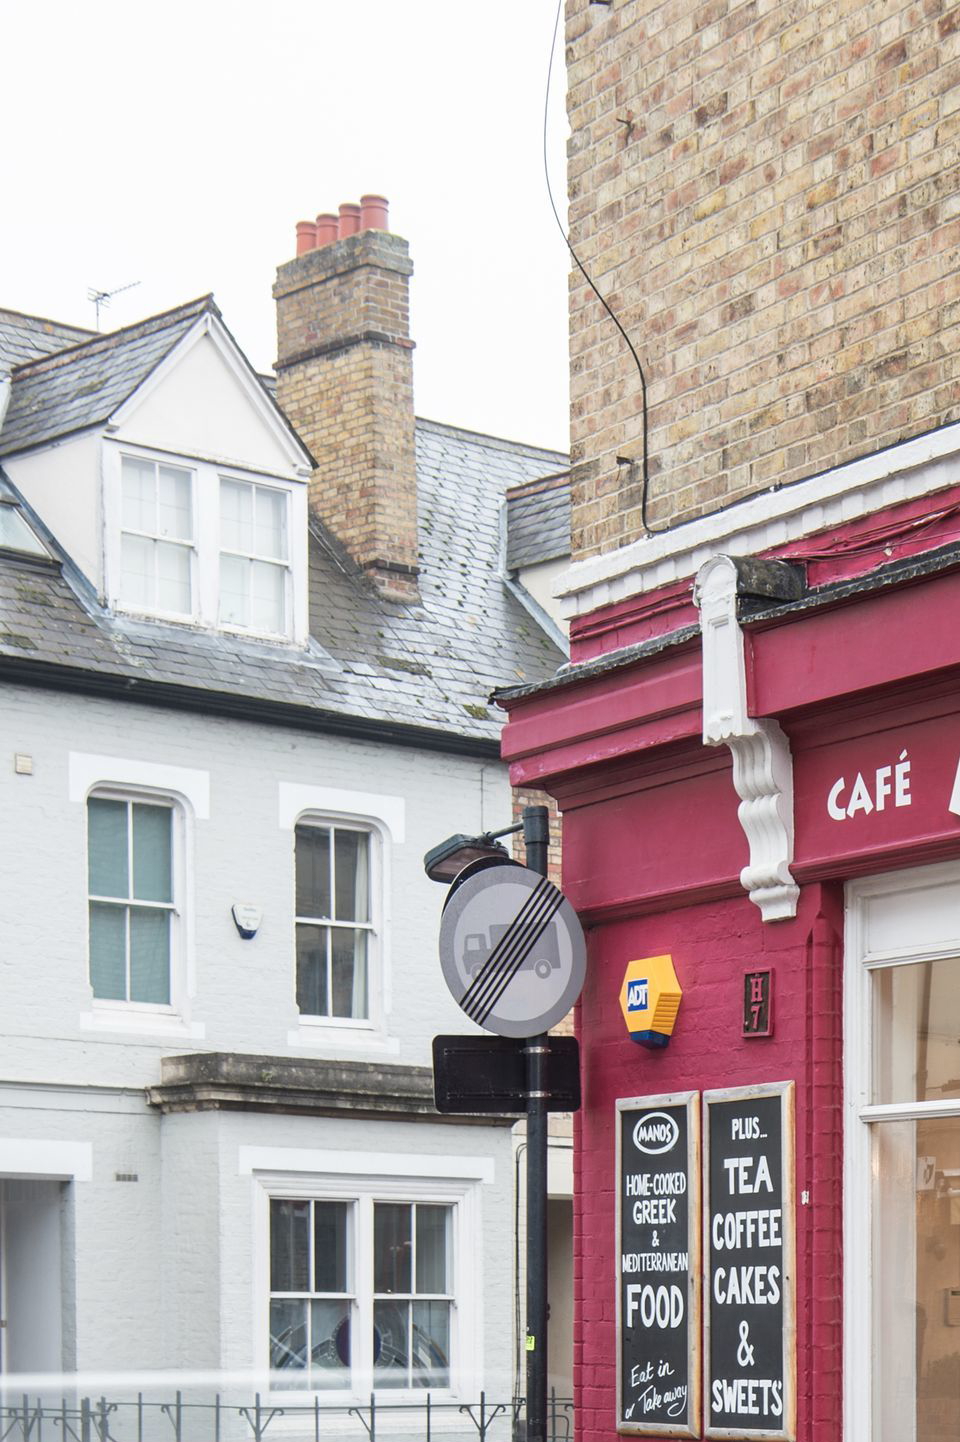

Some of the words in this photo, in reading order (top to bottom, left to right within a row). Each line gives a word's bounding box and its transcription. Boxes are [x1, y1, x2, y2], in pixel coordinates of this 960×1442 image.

[826, 748, 912, 821] CAFÉ
[627, 983, 649, 1007] ADT
[637, 1122, 672, 1144] MANOS
[626, 1171, 687, 1197] HOME-COOKED
[723, 1155, 774, 1195] TEA
[632, 1198, 677, 1225] GREEK
[651, 1230, 660, 1248] &
[712, 1208, 782, 1251] COFFEE
[621, 1252, 689, 1273] MEDITERRANEAN
[713, 1264, 781, 1305] CAKES
[626, 1283, 684, 1329] FOOD
[736, 1320, 755, 1367] &
[630, 1361, 654, 1388] Eat
[657, 1359, 675, 1377] in
[625, 1403, 635, 1419] or
[711, 1379, 783, 1416] SWEETS
